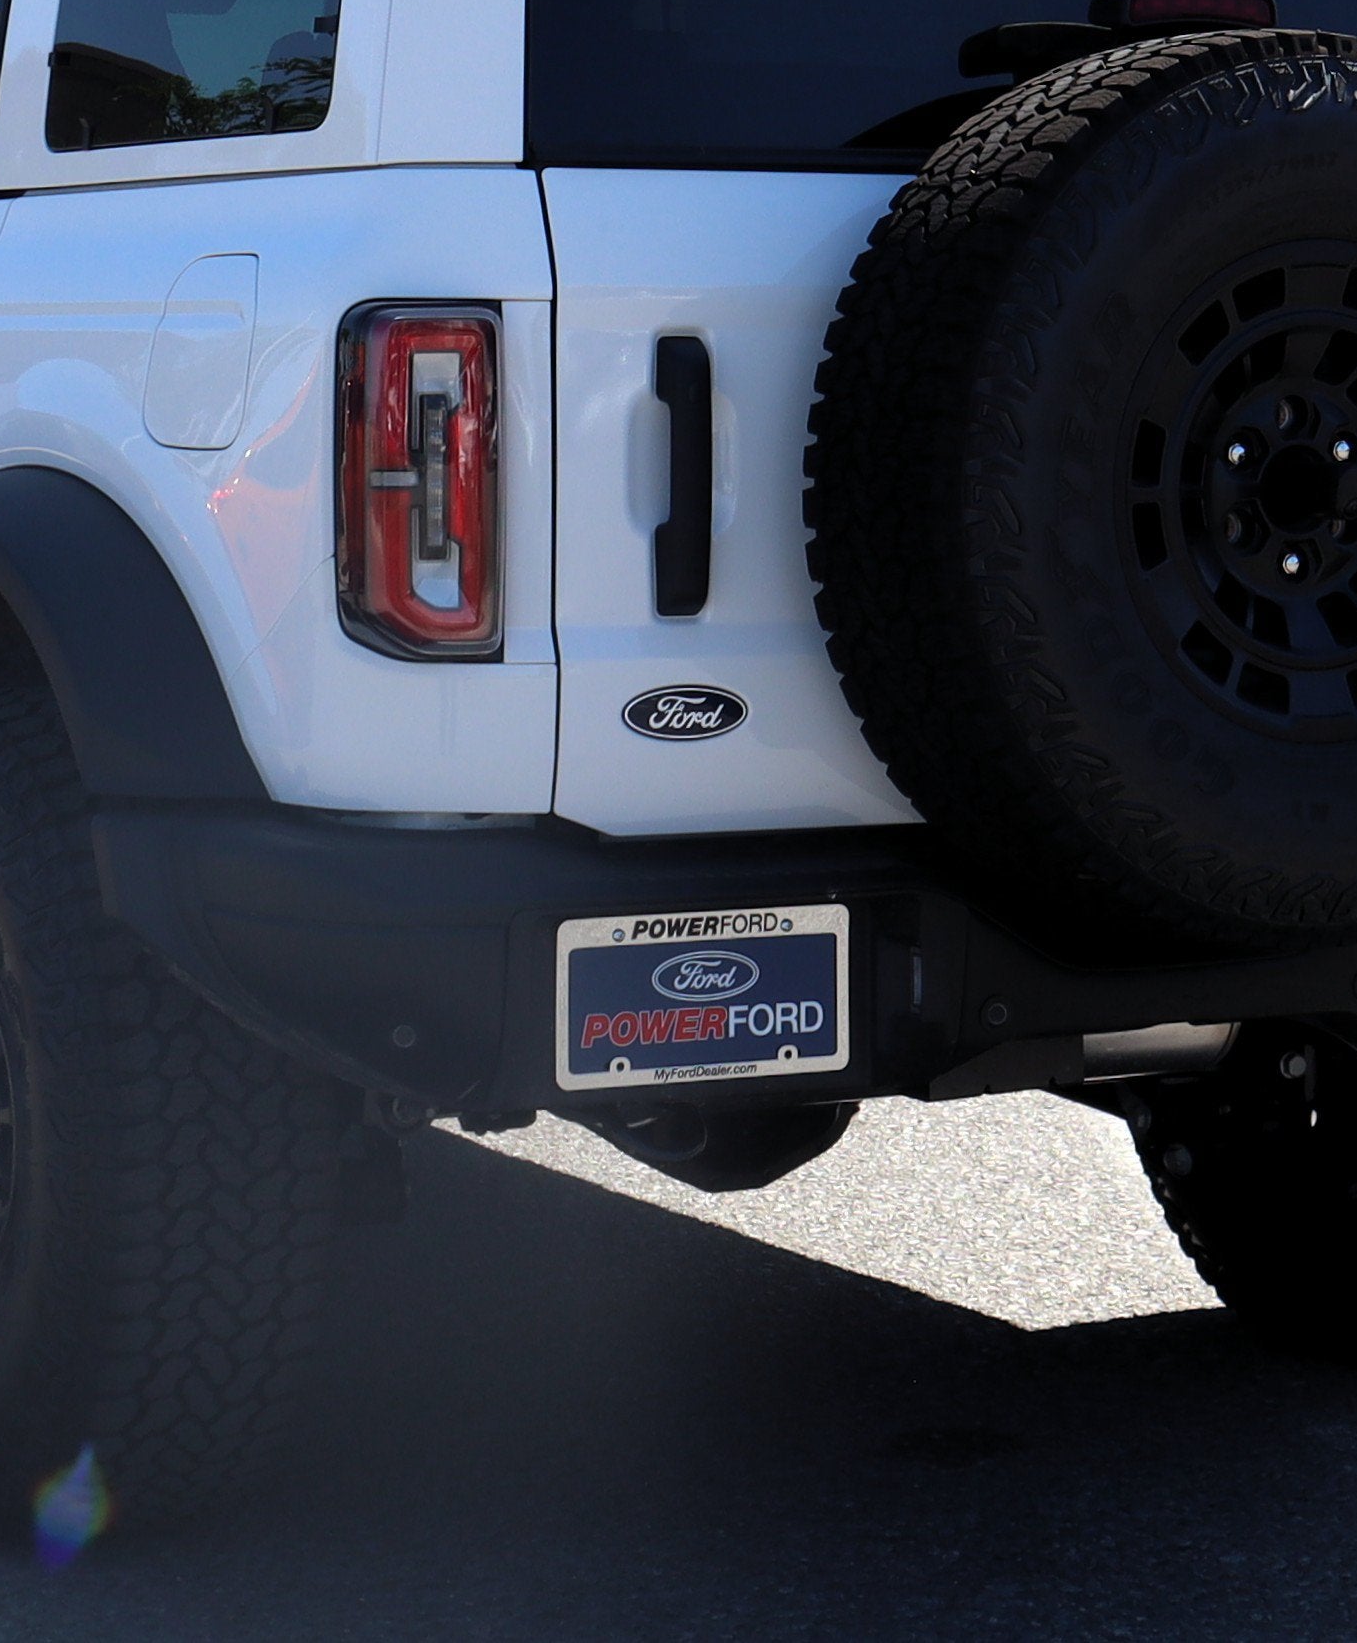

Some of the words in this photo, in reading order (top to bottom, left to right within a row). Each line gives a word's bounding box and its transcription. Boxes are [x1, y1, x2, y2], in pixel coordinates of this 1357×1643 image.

[649, 696, 724, 729] Ford
[631, 912, 778, 940] POWERFORD
[673, 959, 736, 990] Ford
[581, 1000, 824, 1048] POWERFORD
[653, 1063, 757, 1083] MyFordDealer.com
